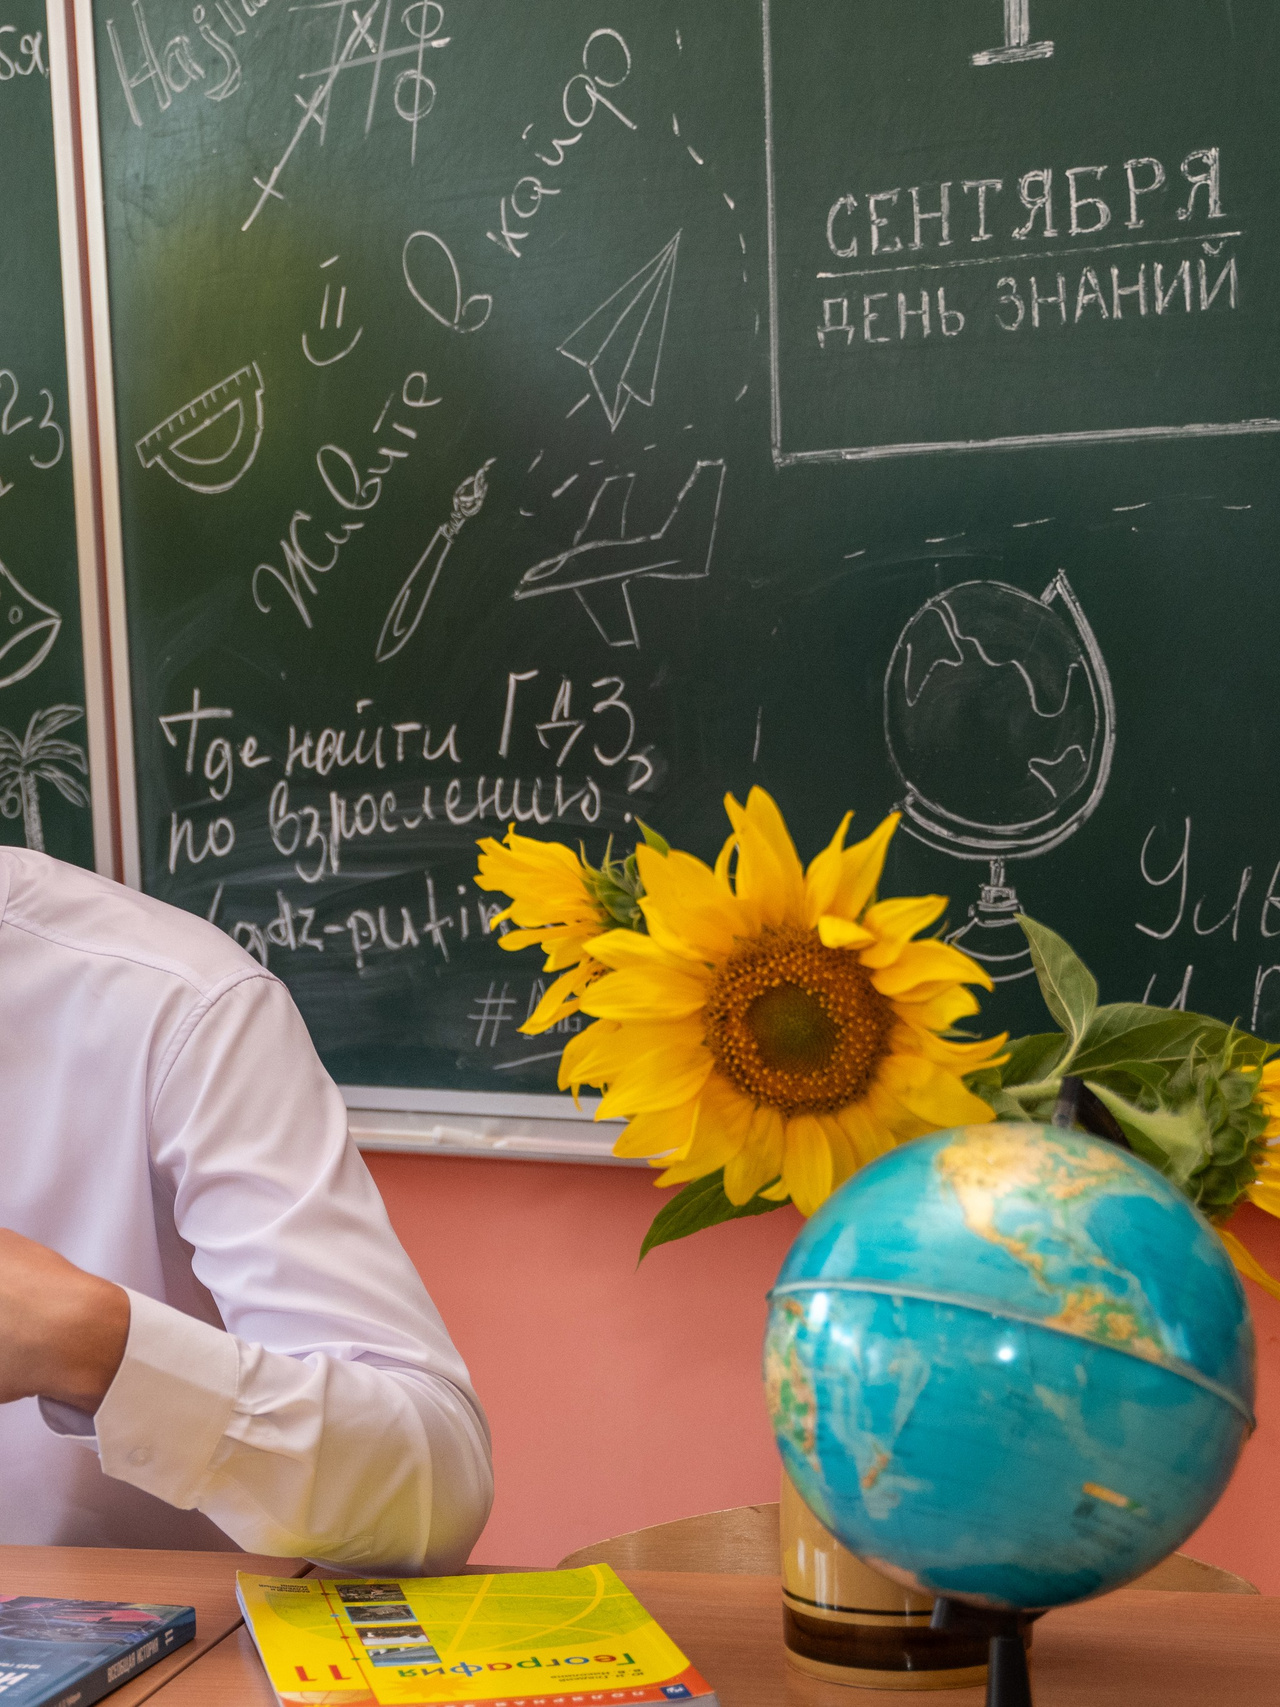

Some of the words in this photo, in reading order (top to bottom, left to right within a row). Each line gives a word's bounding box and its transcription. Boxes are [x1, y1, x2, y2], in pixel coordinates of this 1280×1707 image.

[826, 147, 1228, 259] СЕНТЯБРЯ
[817, 287, 966, 348] ДЕНЬ
[994, 239, 1239, 331] ЗНАНИЙ
[29, 389, 64, 469] 3
[284, 699, 462, 776] найти
[168, 810, 236, 874] по
[293, 1663, 351, 1682] 11
[398, 1652, 635, 1678] География
